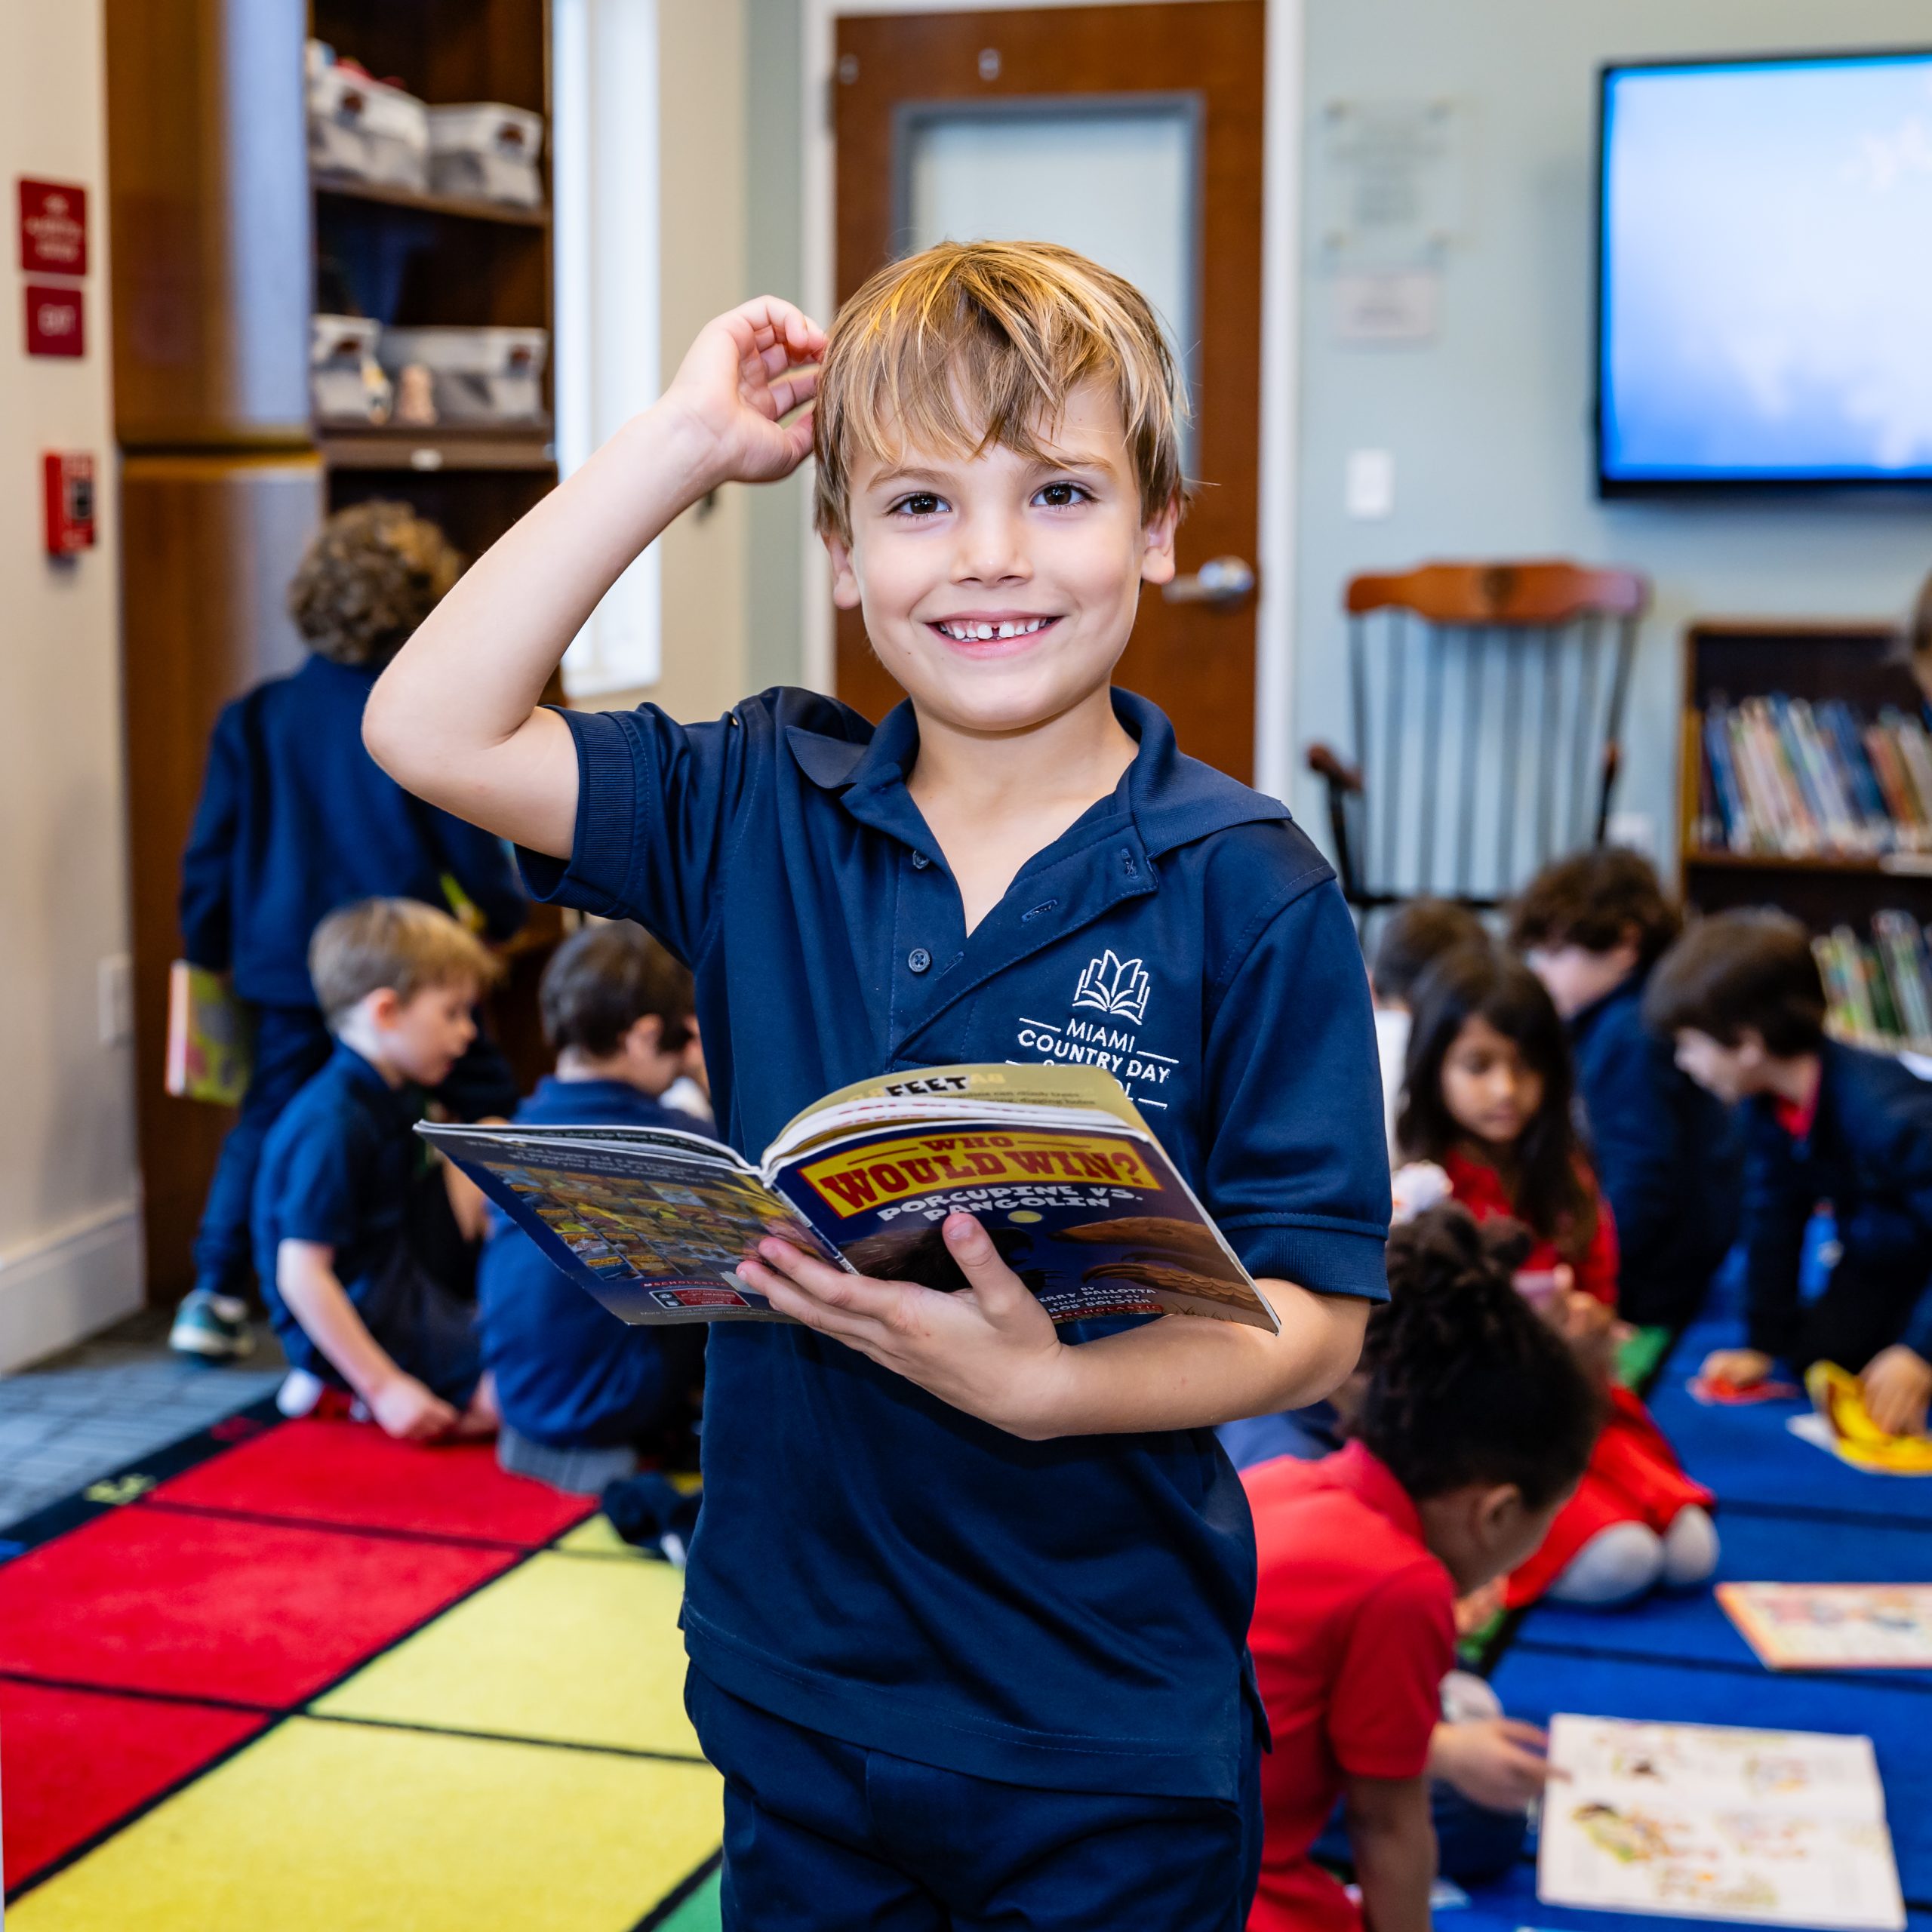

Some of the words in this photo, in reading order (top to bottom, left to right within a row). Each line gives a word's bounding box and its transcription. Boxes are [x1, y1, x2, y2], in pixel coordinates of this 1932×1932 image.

[1066, 1018, 1135, 1053] MIAMI
[1018, 1029, 1123, 1072] COUNTRY
[1125, 1060, 1171, 1084] DAY
[886, 1076, 967, 1097] FEET
[919, 1137, 1015, 1152] WHO
[818, 1152, 1008, 1209] WOULD
[1002, 1150, 1143, 1185] WIN?
[876, 1186, 1080, 1221] PORCUPINE
[1089, 1187, 1143, 1201] VS.
[923, 1197, 1111, 1221] PANGOLIN
[1037, 1293, 1076, 1303] ERRY
[1082, 1287, 1156, 1296] PALLOTTA
[1052, 1294, 1122, 1306] ILLUSTRATED
[1048, 1303, 1081, 1313] ROB
[1065, 1305, 1161, 1317] SCHOLASTIC
